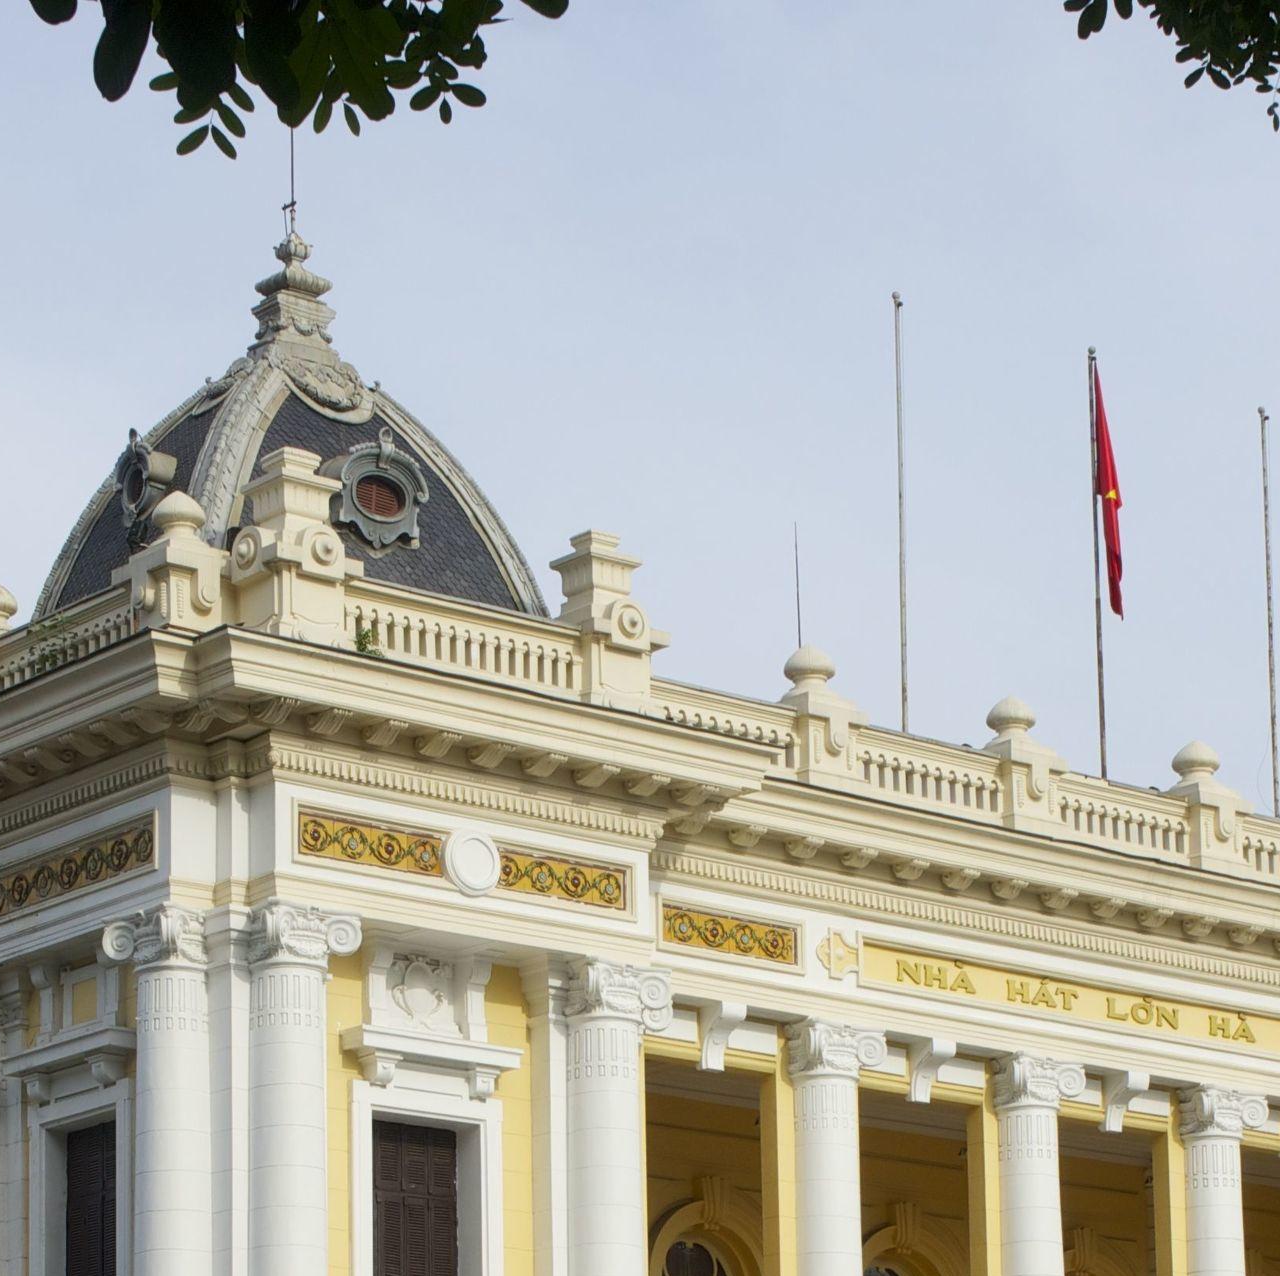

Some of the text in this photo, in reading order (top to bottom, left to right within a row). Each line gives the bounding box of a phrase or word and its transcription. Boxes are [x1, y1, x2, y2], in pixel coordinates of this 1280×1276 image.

[896, 959, 976, 995] NHÀ
[1006, 977, 1079, 1011] HÁT
[1105, 996, 1180, 1030] LỚN
[1208, 1011, 1256, 1043] HÀ
